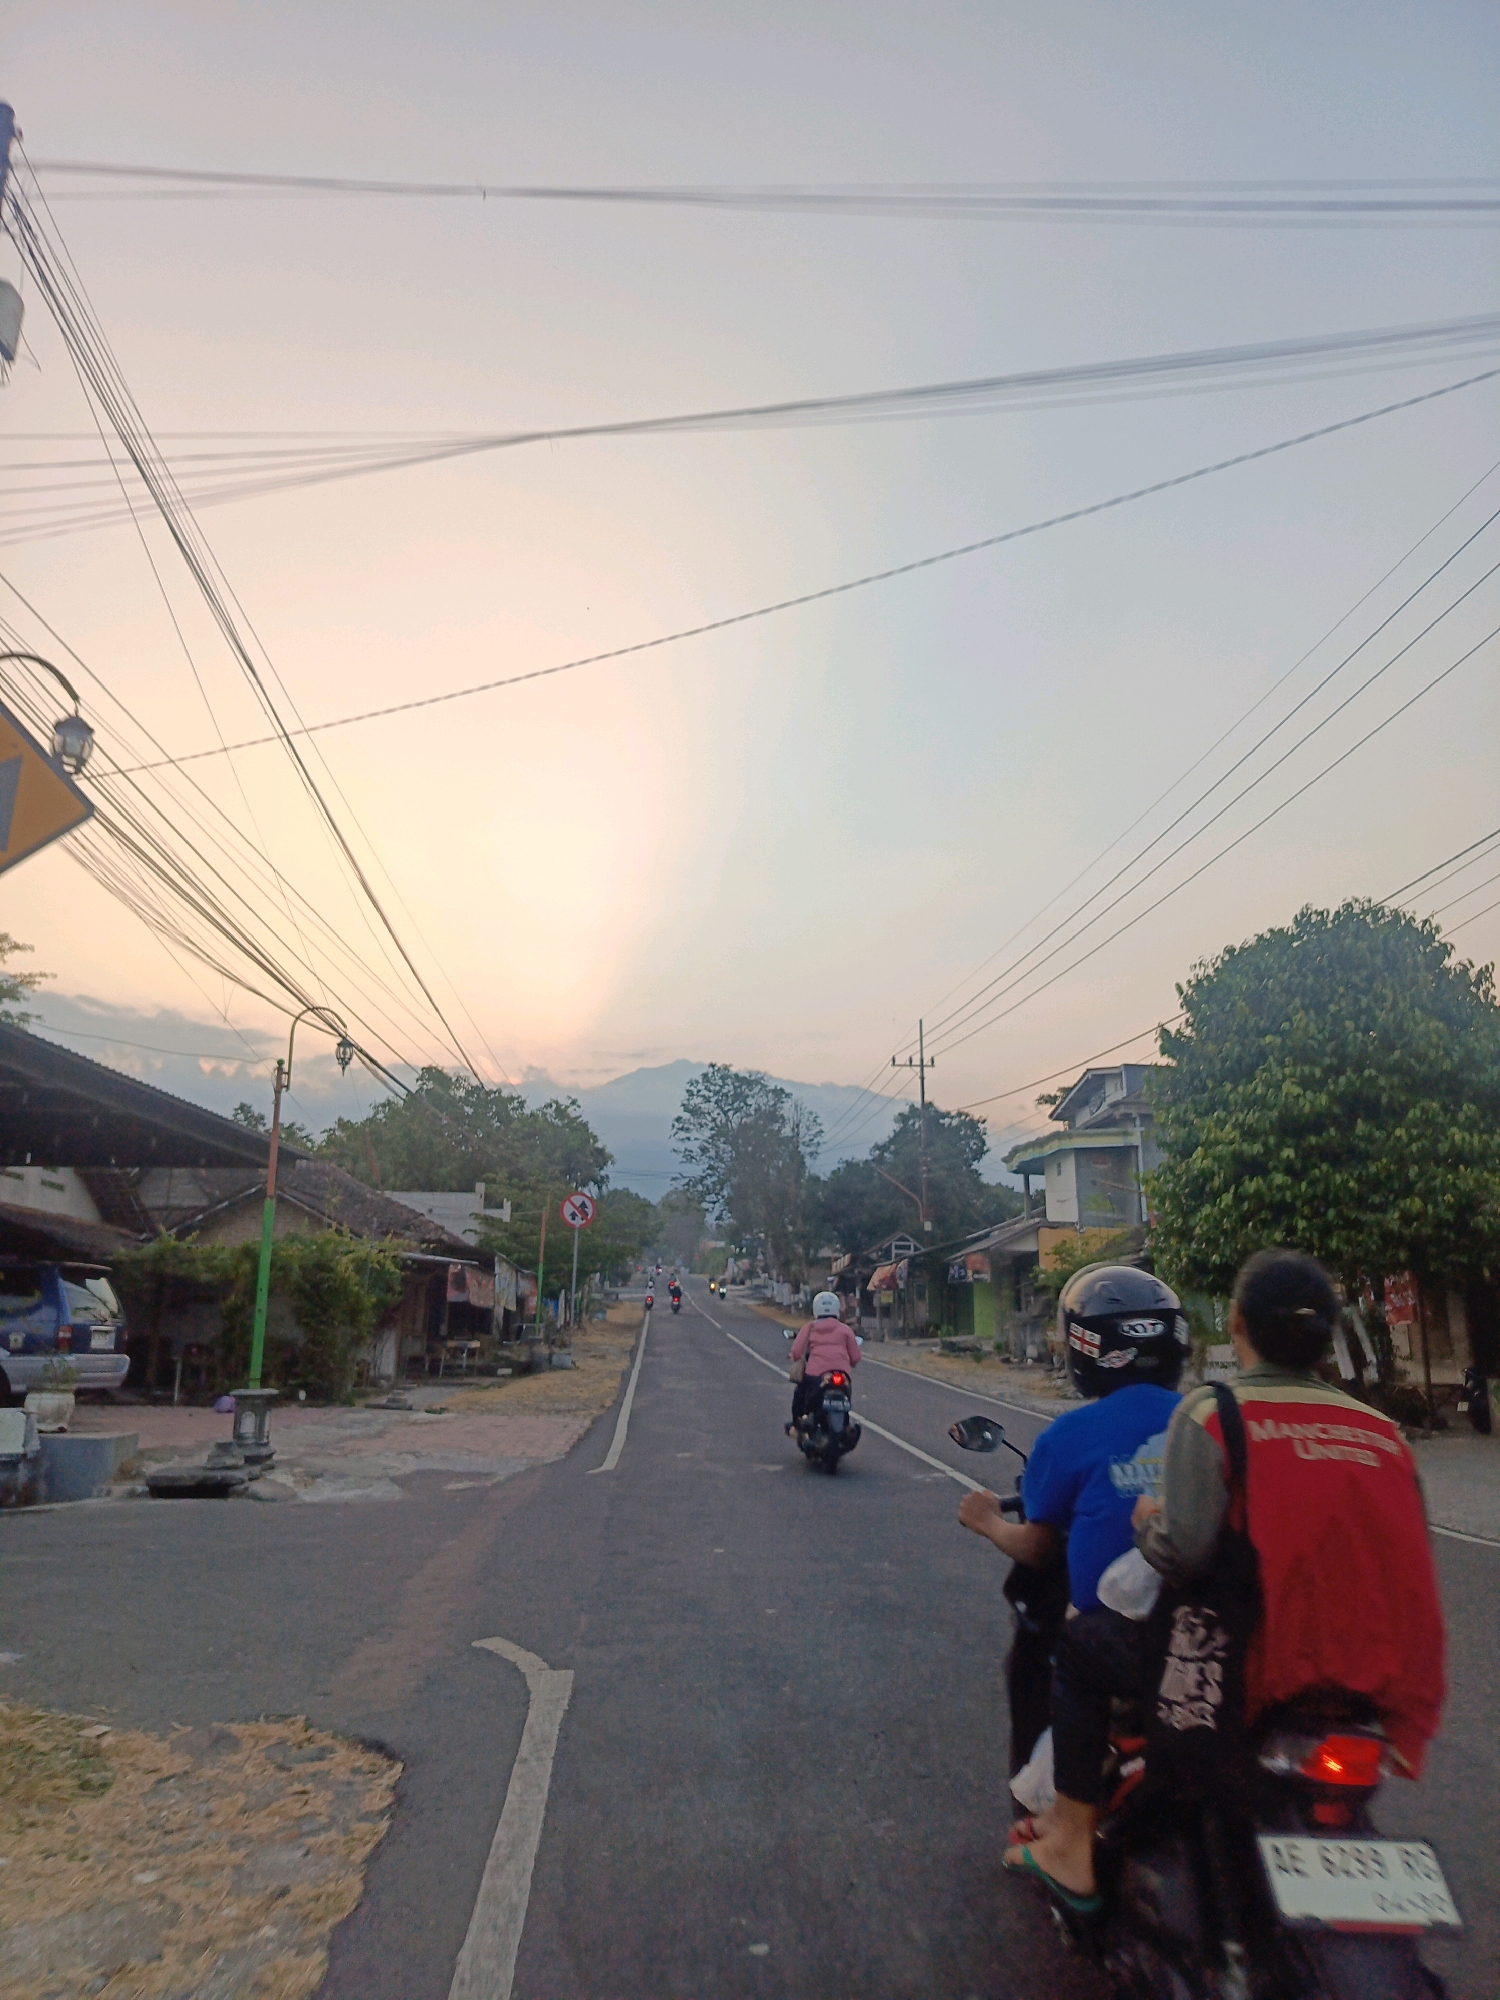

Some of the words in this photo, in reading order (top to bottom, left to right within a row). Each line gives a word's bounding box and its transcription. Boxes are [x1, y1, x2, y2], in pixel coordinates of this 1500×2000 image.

[1121, 1319, 1165, 1336] KYT
[1247, 1419, 1403, 1457] MANCHESTER
[1293, 1438, 1381, 1467] UNITED
